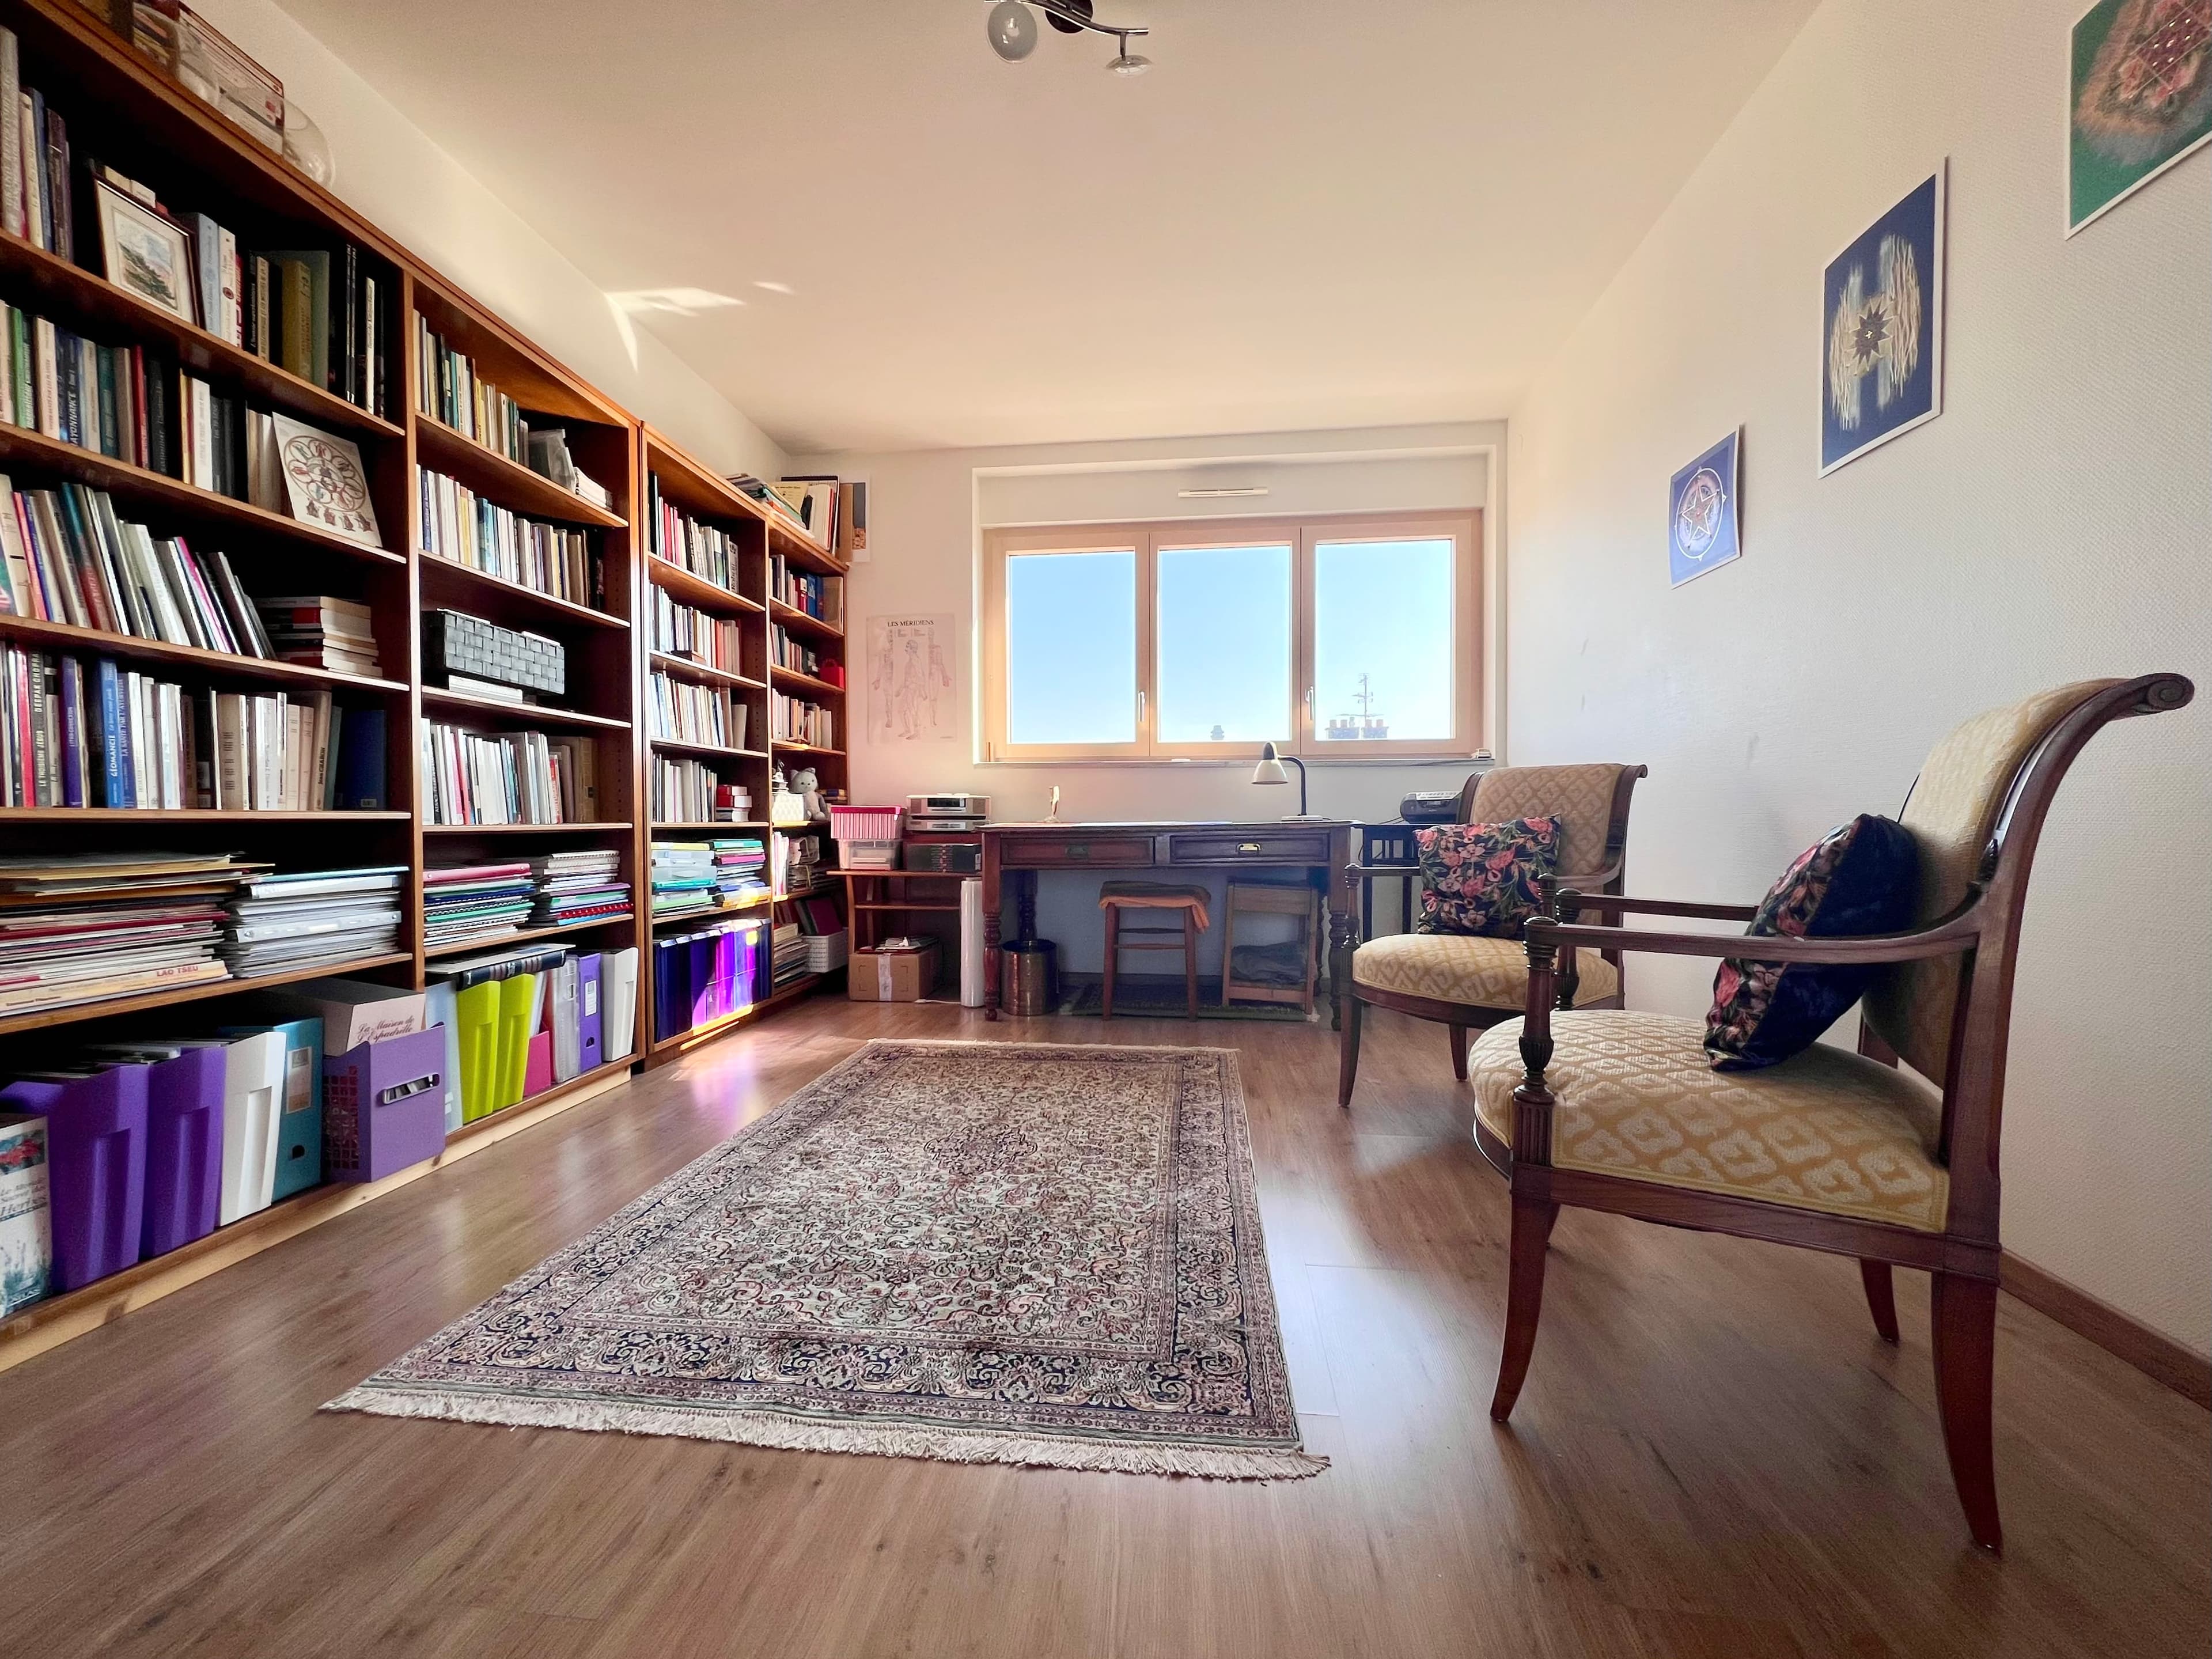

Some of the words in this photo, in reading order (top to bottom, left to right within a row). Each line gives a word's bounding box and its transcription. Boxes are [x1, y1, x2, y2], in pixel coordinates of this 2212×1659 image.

[31, 653, 41, 682] CHOPRA
[32, 684, 42, 712] DEEPAK
[107, 734, 118, 777] GÉOMANCIE
[177, 965, 198, 974] TSEU
[377, 1019, 404, 1030] Maison
